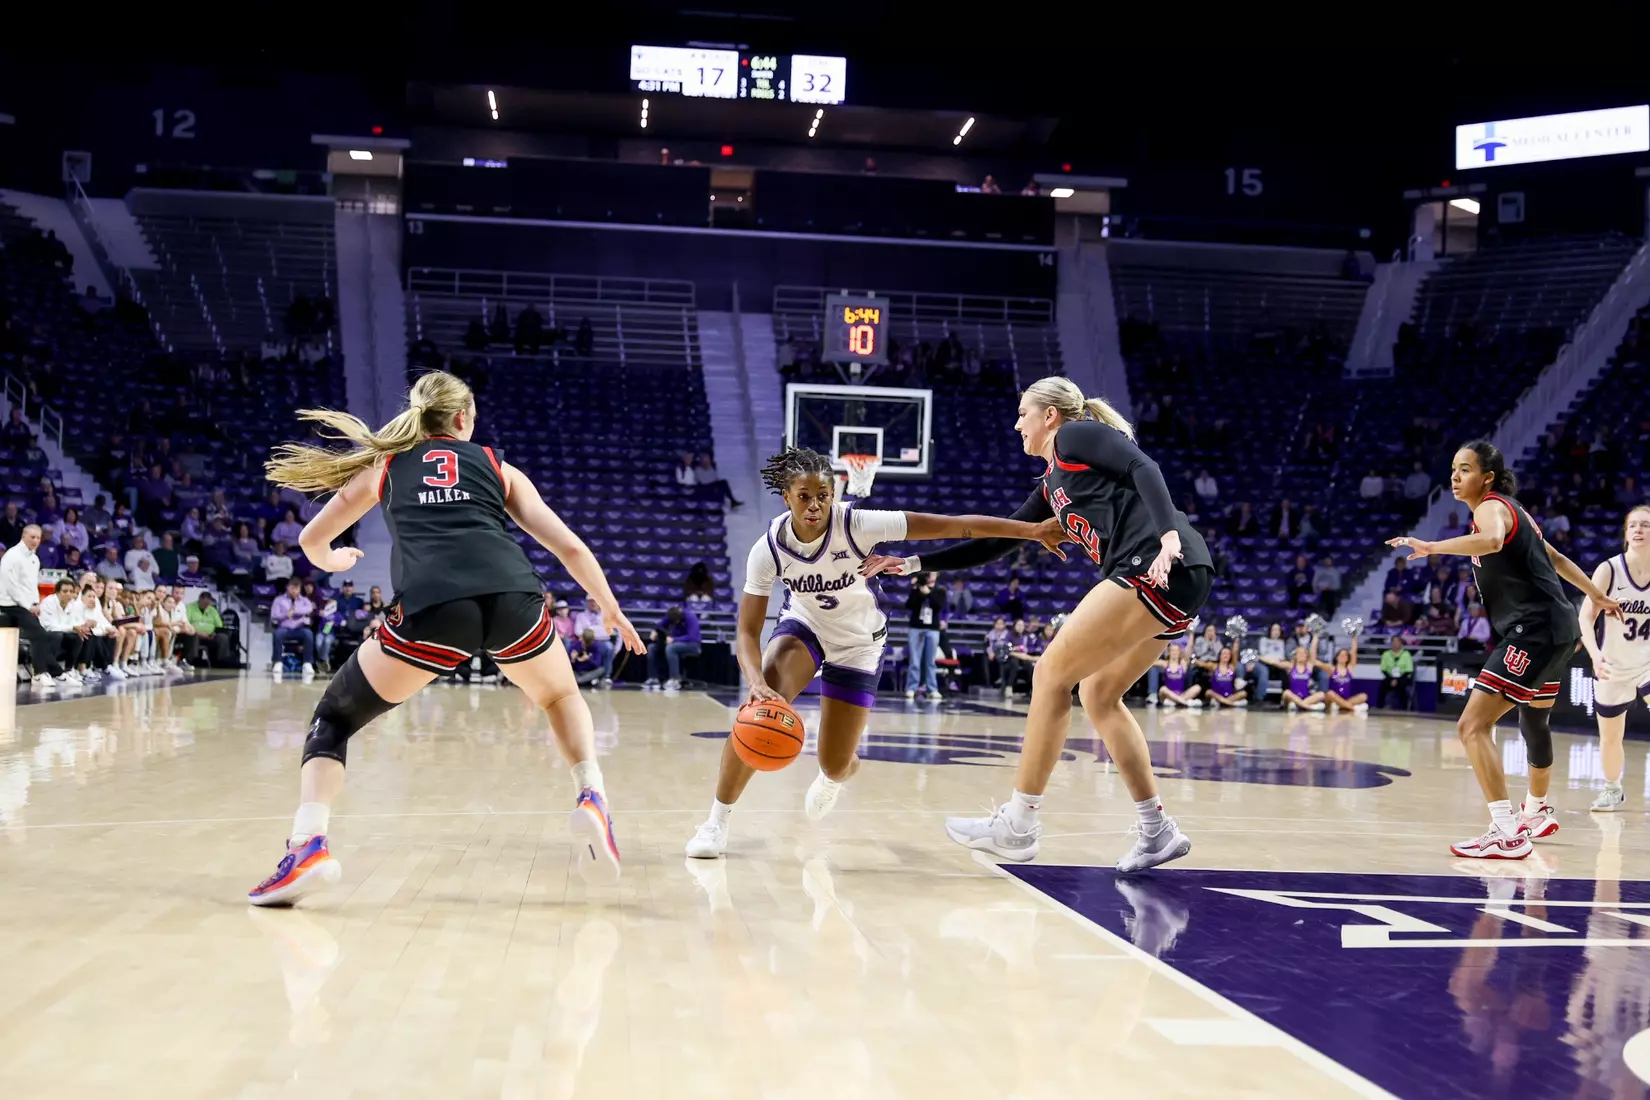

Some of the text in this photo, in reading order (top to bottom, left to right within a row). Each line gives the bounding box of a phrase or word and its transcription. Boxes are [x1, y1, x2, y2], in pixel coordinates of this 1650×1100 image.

[697, 67, 724, 86] 17
[803, 72, 831, 93] 32
[152, 108, 196, 139] 12
[1224, 168, 1263, 196] 15
[408, 221, 424, 234] 13
[1038, 254, 1053, 266] 14
[844, 306, 880, 325] 6:44
[849, 325, 874, 355] 10
[422, 449, 459, 488] 3
[782, 570, 857, 593] Wildcats
[815, 594, 840, 611] 3
[1623, 617, 1650, 641] 34
[754, 708, 795, 731] ELITE
